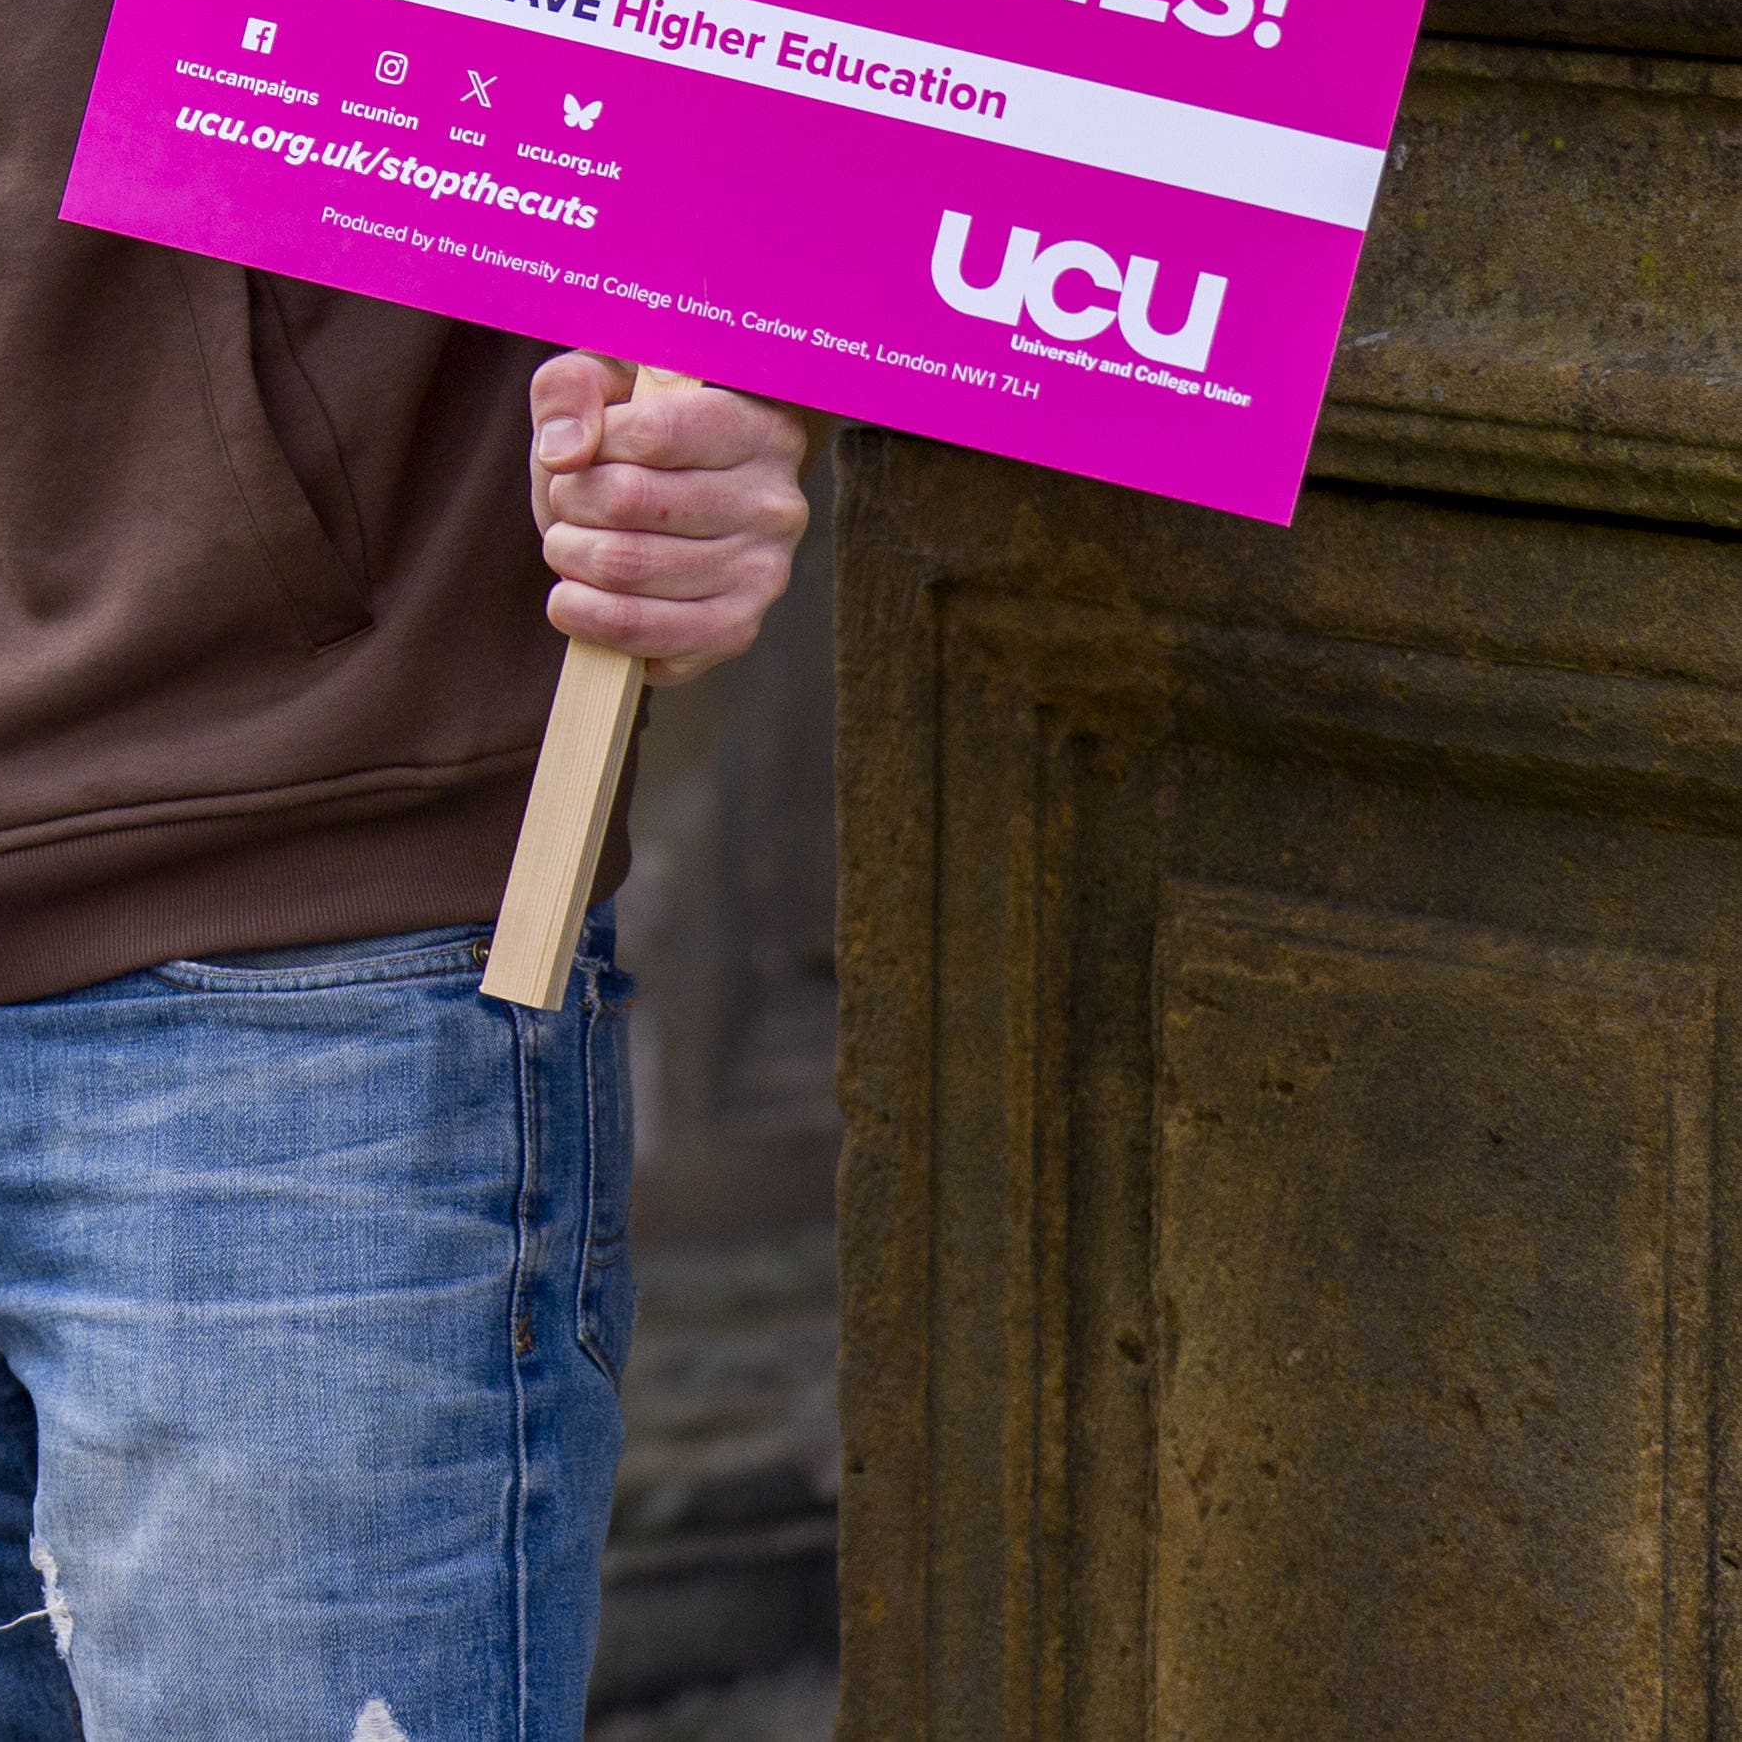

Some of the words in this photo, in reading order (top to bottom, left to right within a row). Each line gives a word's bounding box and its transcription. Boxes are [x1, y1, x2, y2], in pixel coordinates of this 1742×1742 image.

[176, 60, 318, 105] ucu.campaigns
[777, 32, 1006, 118] Education
[341, 100, 418, 130] ucunion
[450, 127, 485, 146] ucu
[176, 106, 598, 229] ucu.org.uk/stopthecuts
[517, 143, 621, 179] ucu.org.uk
[322, 207, 408, 242] Produced
[412, 230, 434, 251] by
[438, 237, 466, 256] the
[472, 244, 560, 282] University
[564, 271, 598, 289] and
[604, 277, 672, 308] College
[678, 295, 734, 325] Union,
[742, 312, 807, 340] Carlow
[811, 329, 869, 359] Street,
[877, 345, 946, 376] London
[952, 364, 995, 388] NW1
[1002, 375, 1039, 399] 7LH
[1011, 334, 1098, 370] University
[1099, 360, 1133, 377] and
[1135, 365, 1200, 394] College
